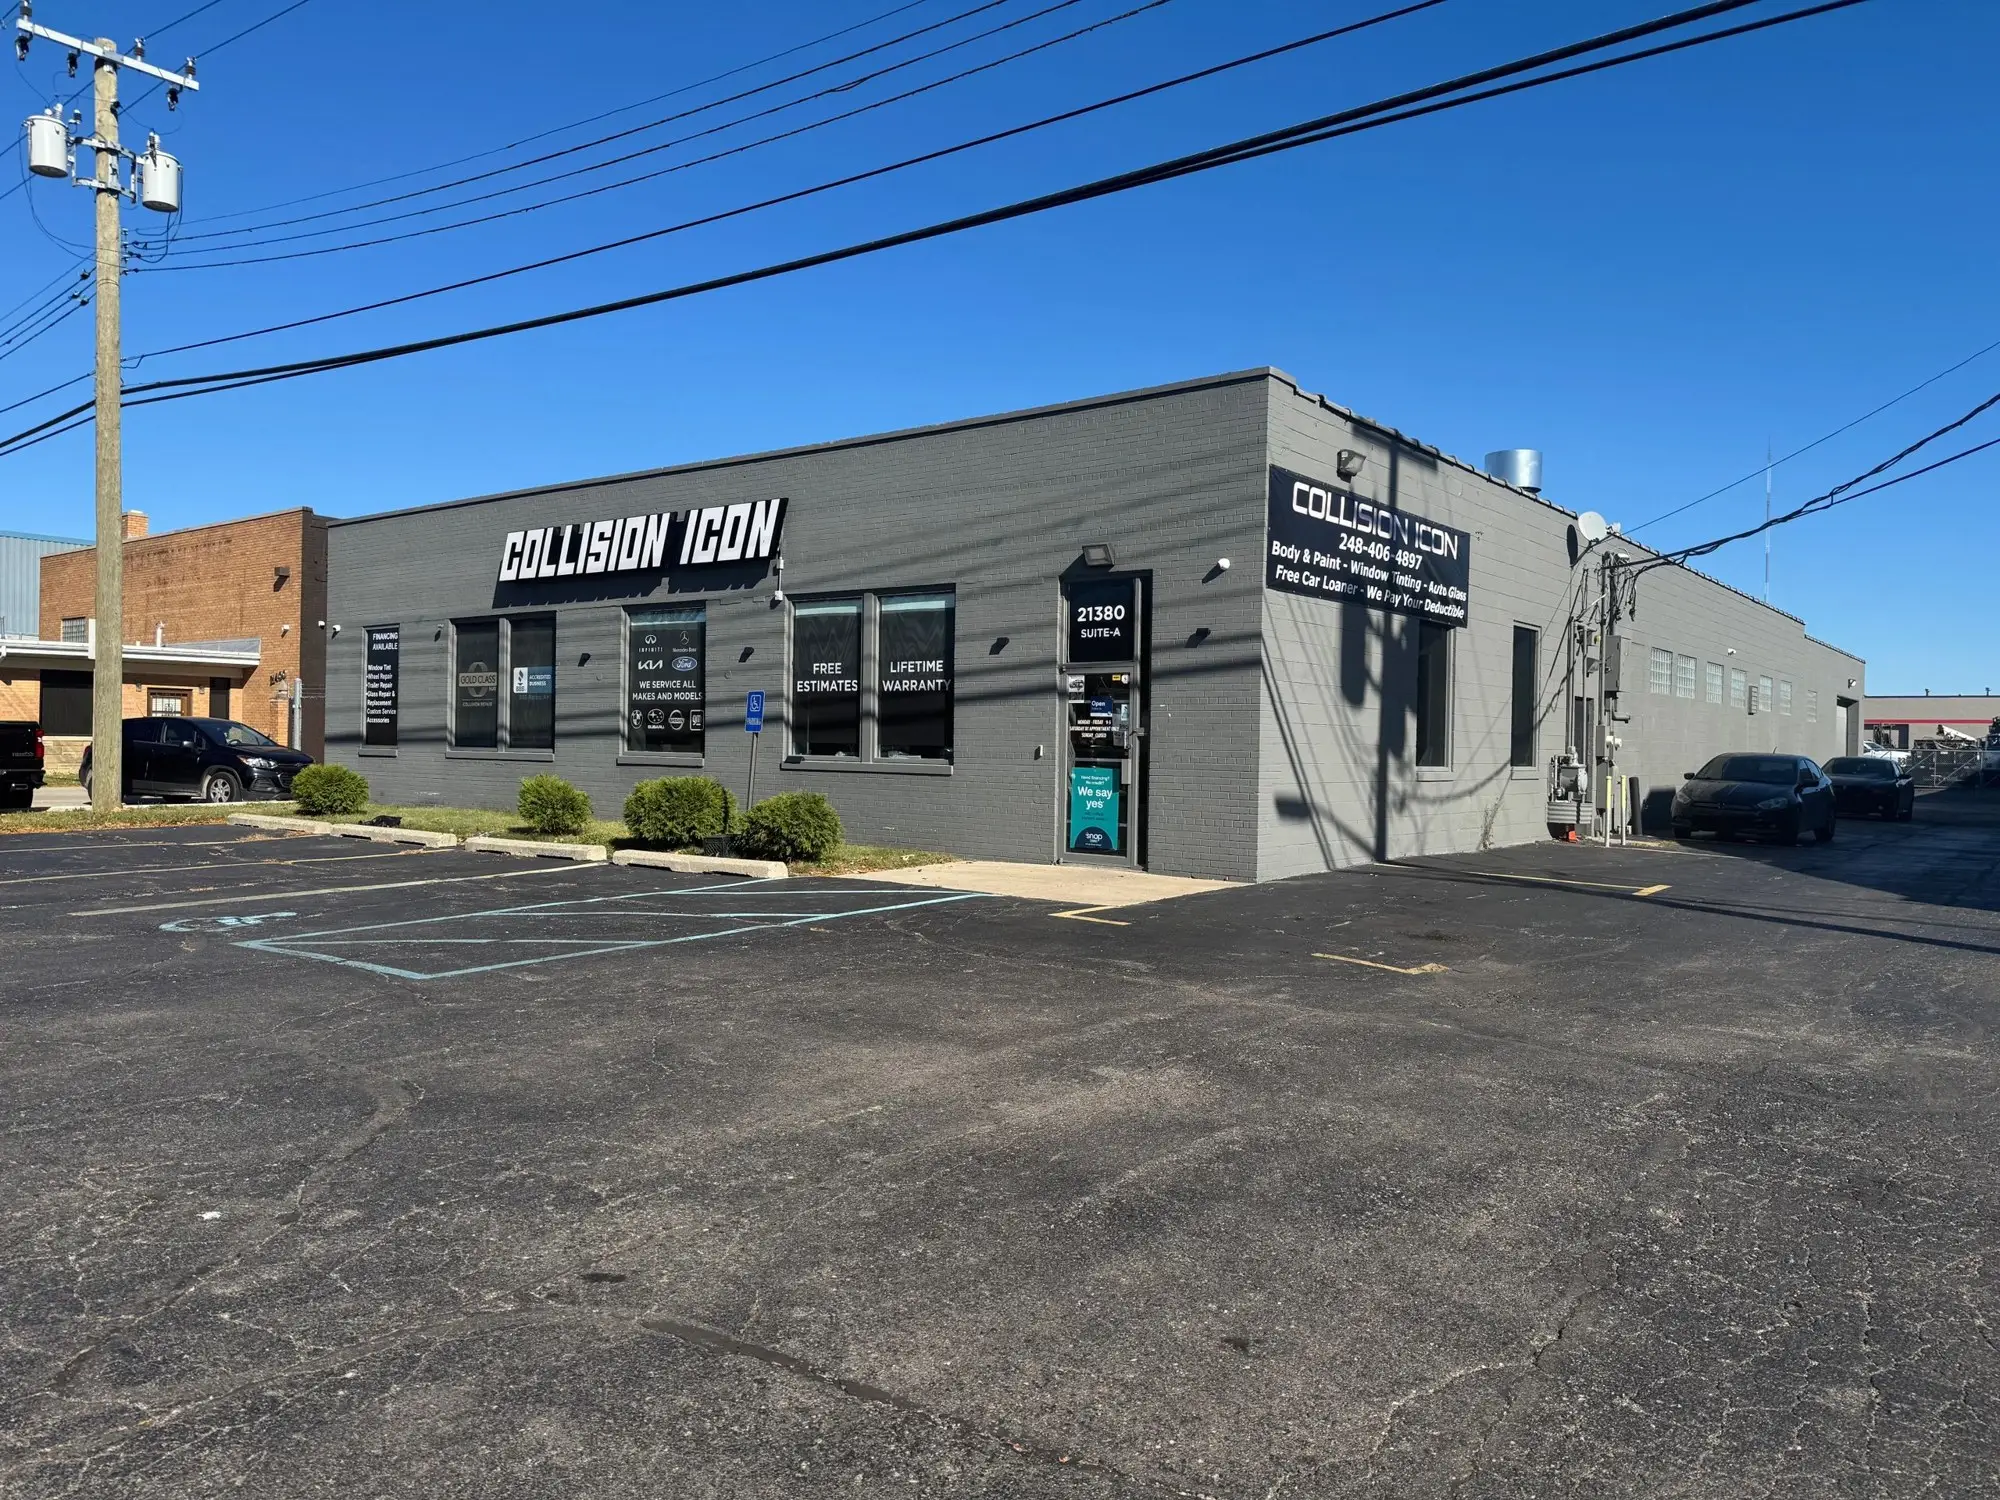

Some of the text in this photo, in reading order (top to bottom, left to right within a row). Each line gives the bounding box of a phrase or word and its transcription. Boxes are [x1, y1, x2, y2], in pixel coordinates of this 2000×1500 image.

[1292, 481, 1458, 560] COLLISION ICON
[499, 499, 780, 581] COLLISION ICON
[1338, 533, 1423, 570] 248-406-4897
[1271, 540, 1301, 563] Body
[1302, 548, 1311, 563] &
[1313, 551, 1341, 571] Paint
[1350, 560, 1389, 582] Window
[1391, 570, 1421, 591] Tinting
[1428, 580, 1447, 596] Auto
[1448, 584, 1467, 602] Glass
[1275, 564, 1300, 583] Free
[1302, 571, 1320, 588] Car
[1322, 575, 1359, 595] Loaner
[1366, 585, 1382, 601] We
[1384, 589, 1402, 608] Pay
[1403, 593, 1423, 610] Your
[1424, 599, 1465, 619] Deductible
[1077, 604, 1126, 622] 21380
[372, 632, 399, 641] FINANCING
[1080, 627, 1121, 638] SUITE-A
[372, 642, 398, 651] AVAILABLE
[813, 662, 842, 675] FREE
[890, 660, 944, 673] LIFETIME
[460, 674, 496, 684] GOLD CLASS
[639, 680, 697, 689] WE SERVICE ALL
[796, 679, 858, 692] ESTIMATES
[882, 679, 951, 692] WARRANTY
[632, 691, 703, 701] MAKES AND MODELS
[1077, 785, 1113, 800] We say
[1085, 800, 1104, 810] yes
